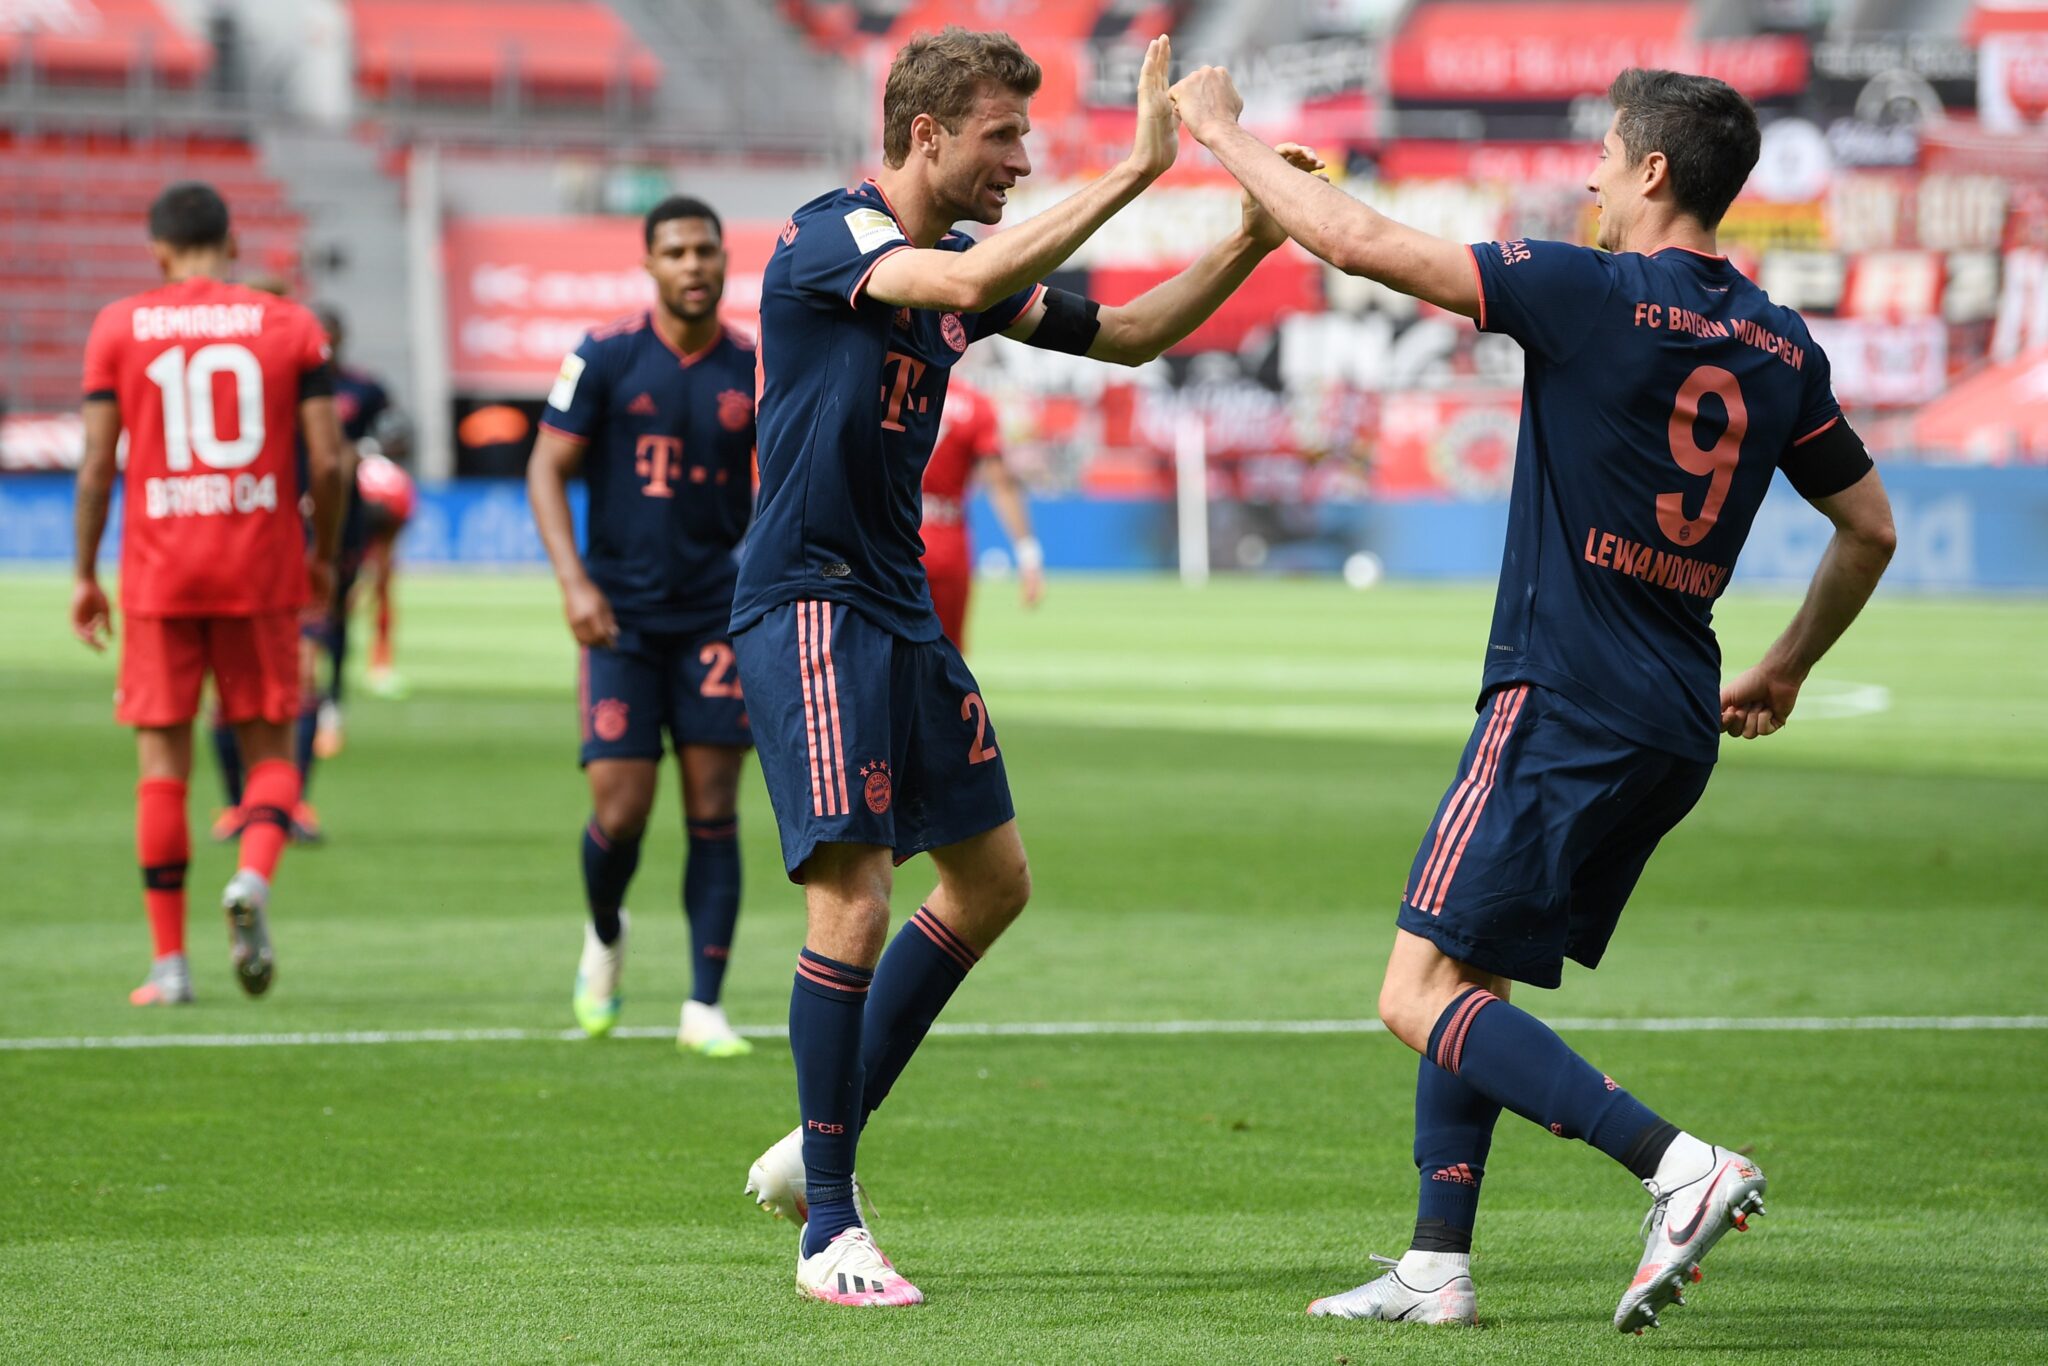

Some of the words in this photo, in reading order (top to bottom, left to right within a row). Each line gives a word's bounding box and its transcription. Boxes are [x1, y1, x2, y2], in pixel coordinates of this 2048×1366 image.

[1634, 303, 1662, 329] FC
[1669, 306, 1730, 338] BAYERN
[145, 343, 266, 472] 10
[1656, 365, 1748, 547] 9
[233, 472, 277, 514] 04
[808, 1119, 844, 1135] FCB
[1432, 1173, 1477, 1188] adidas
